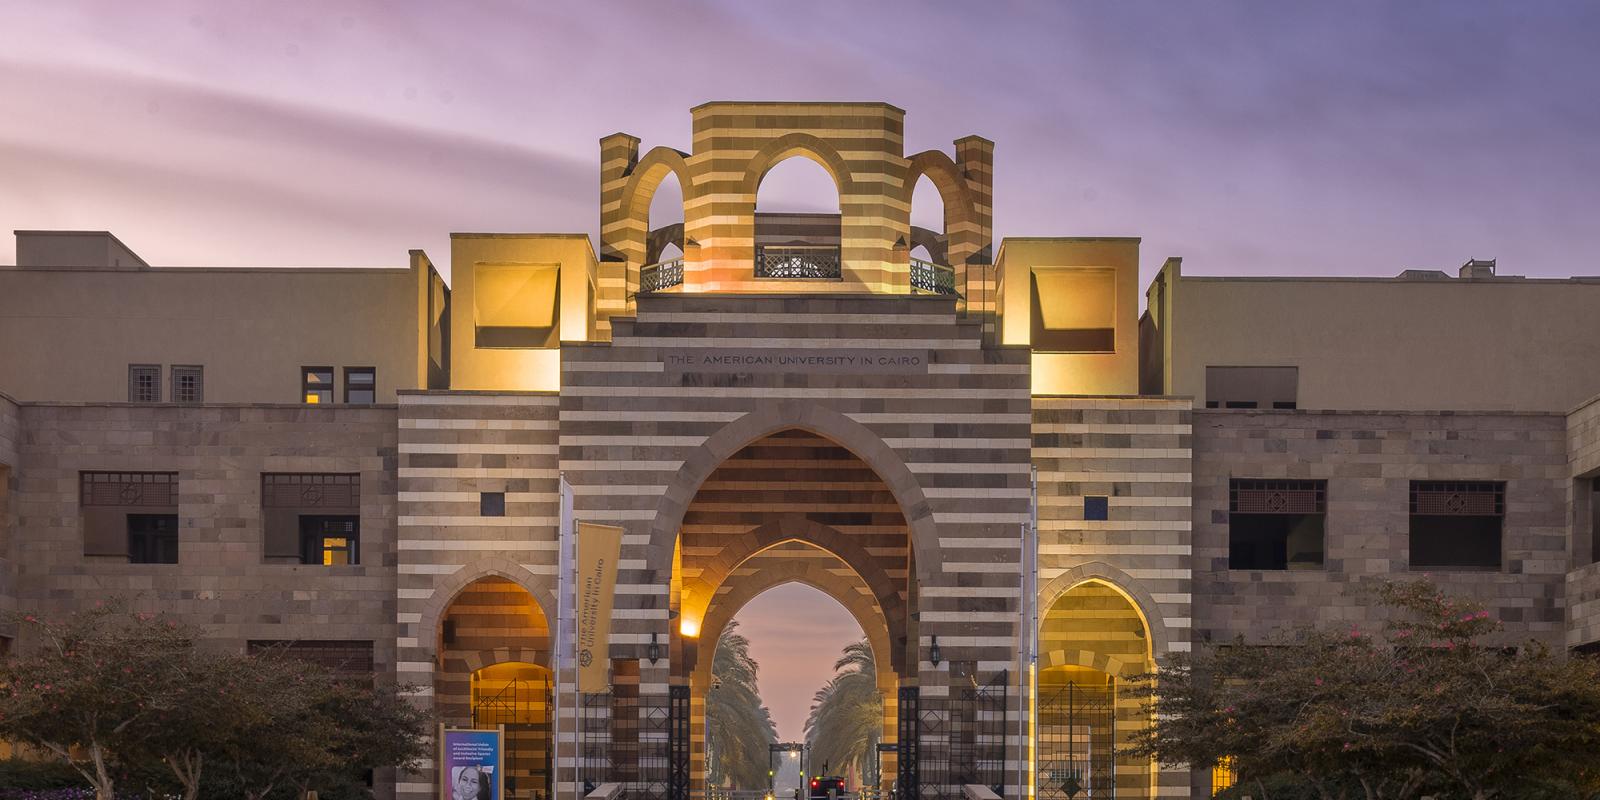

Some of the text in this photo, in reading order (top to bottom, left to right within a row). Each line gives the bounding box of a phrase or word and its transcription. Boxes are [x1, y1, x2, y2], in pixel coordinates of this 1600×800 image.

[669, 355, 920, 366] THE AMERICAN UNIVERSITY IN CAIRO
[582, 577, 592, 625] American
[586, 558, 604, 648] University in Cairo
